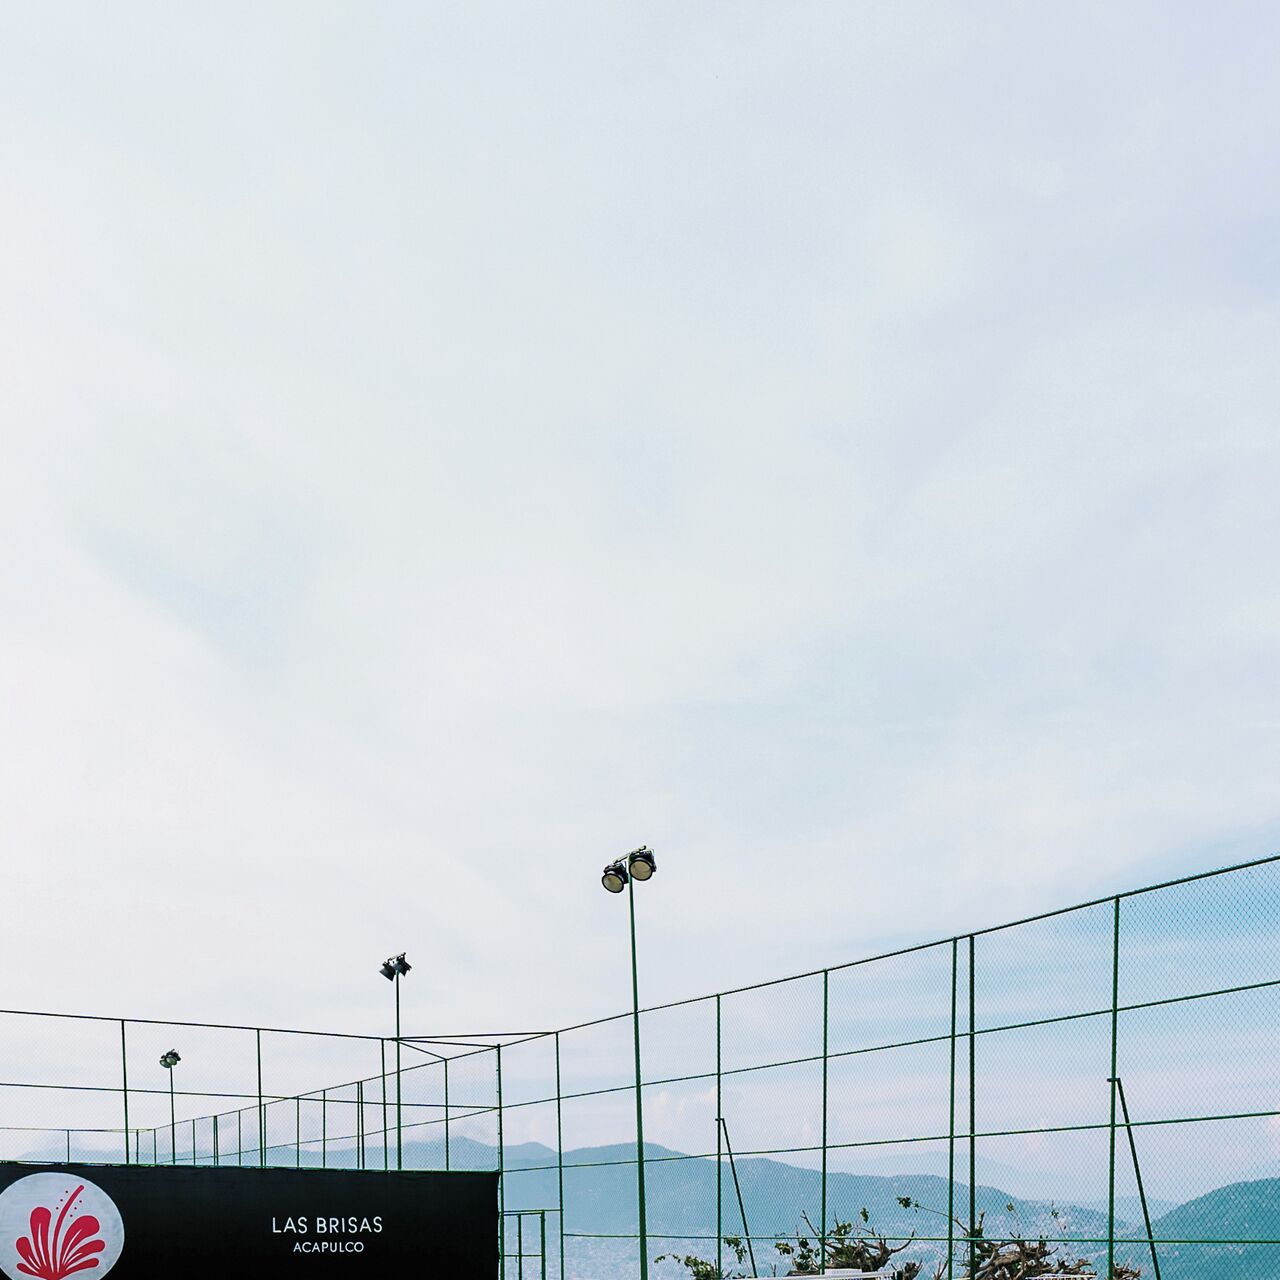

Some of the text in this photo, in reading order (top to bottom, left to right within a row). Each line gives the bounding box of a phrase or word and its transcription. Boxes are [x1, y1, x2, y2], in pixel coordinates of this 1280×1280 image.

[272, 1216, 383, 1234] LAS BRISAS
[293, 1241, 365, 1253] ACAPULCO
